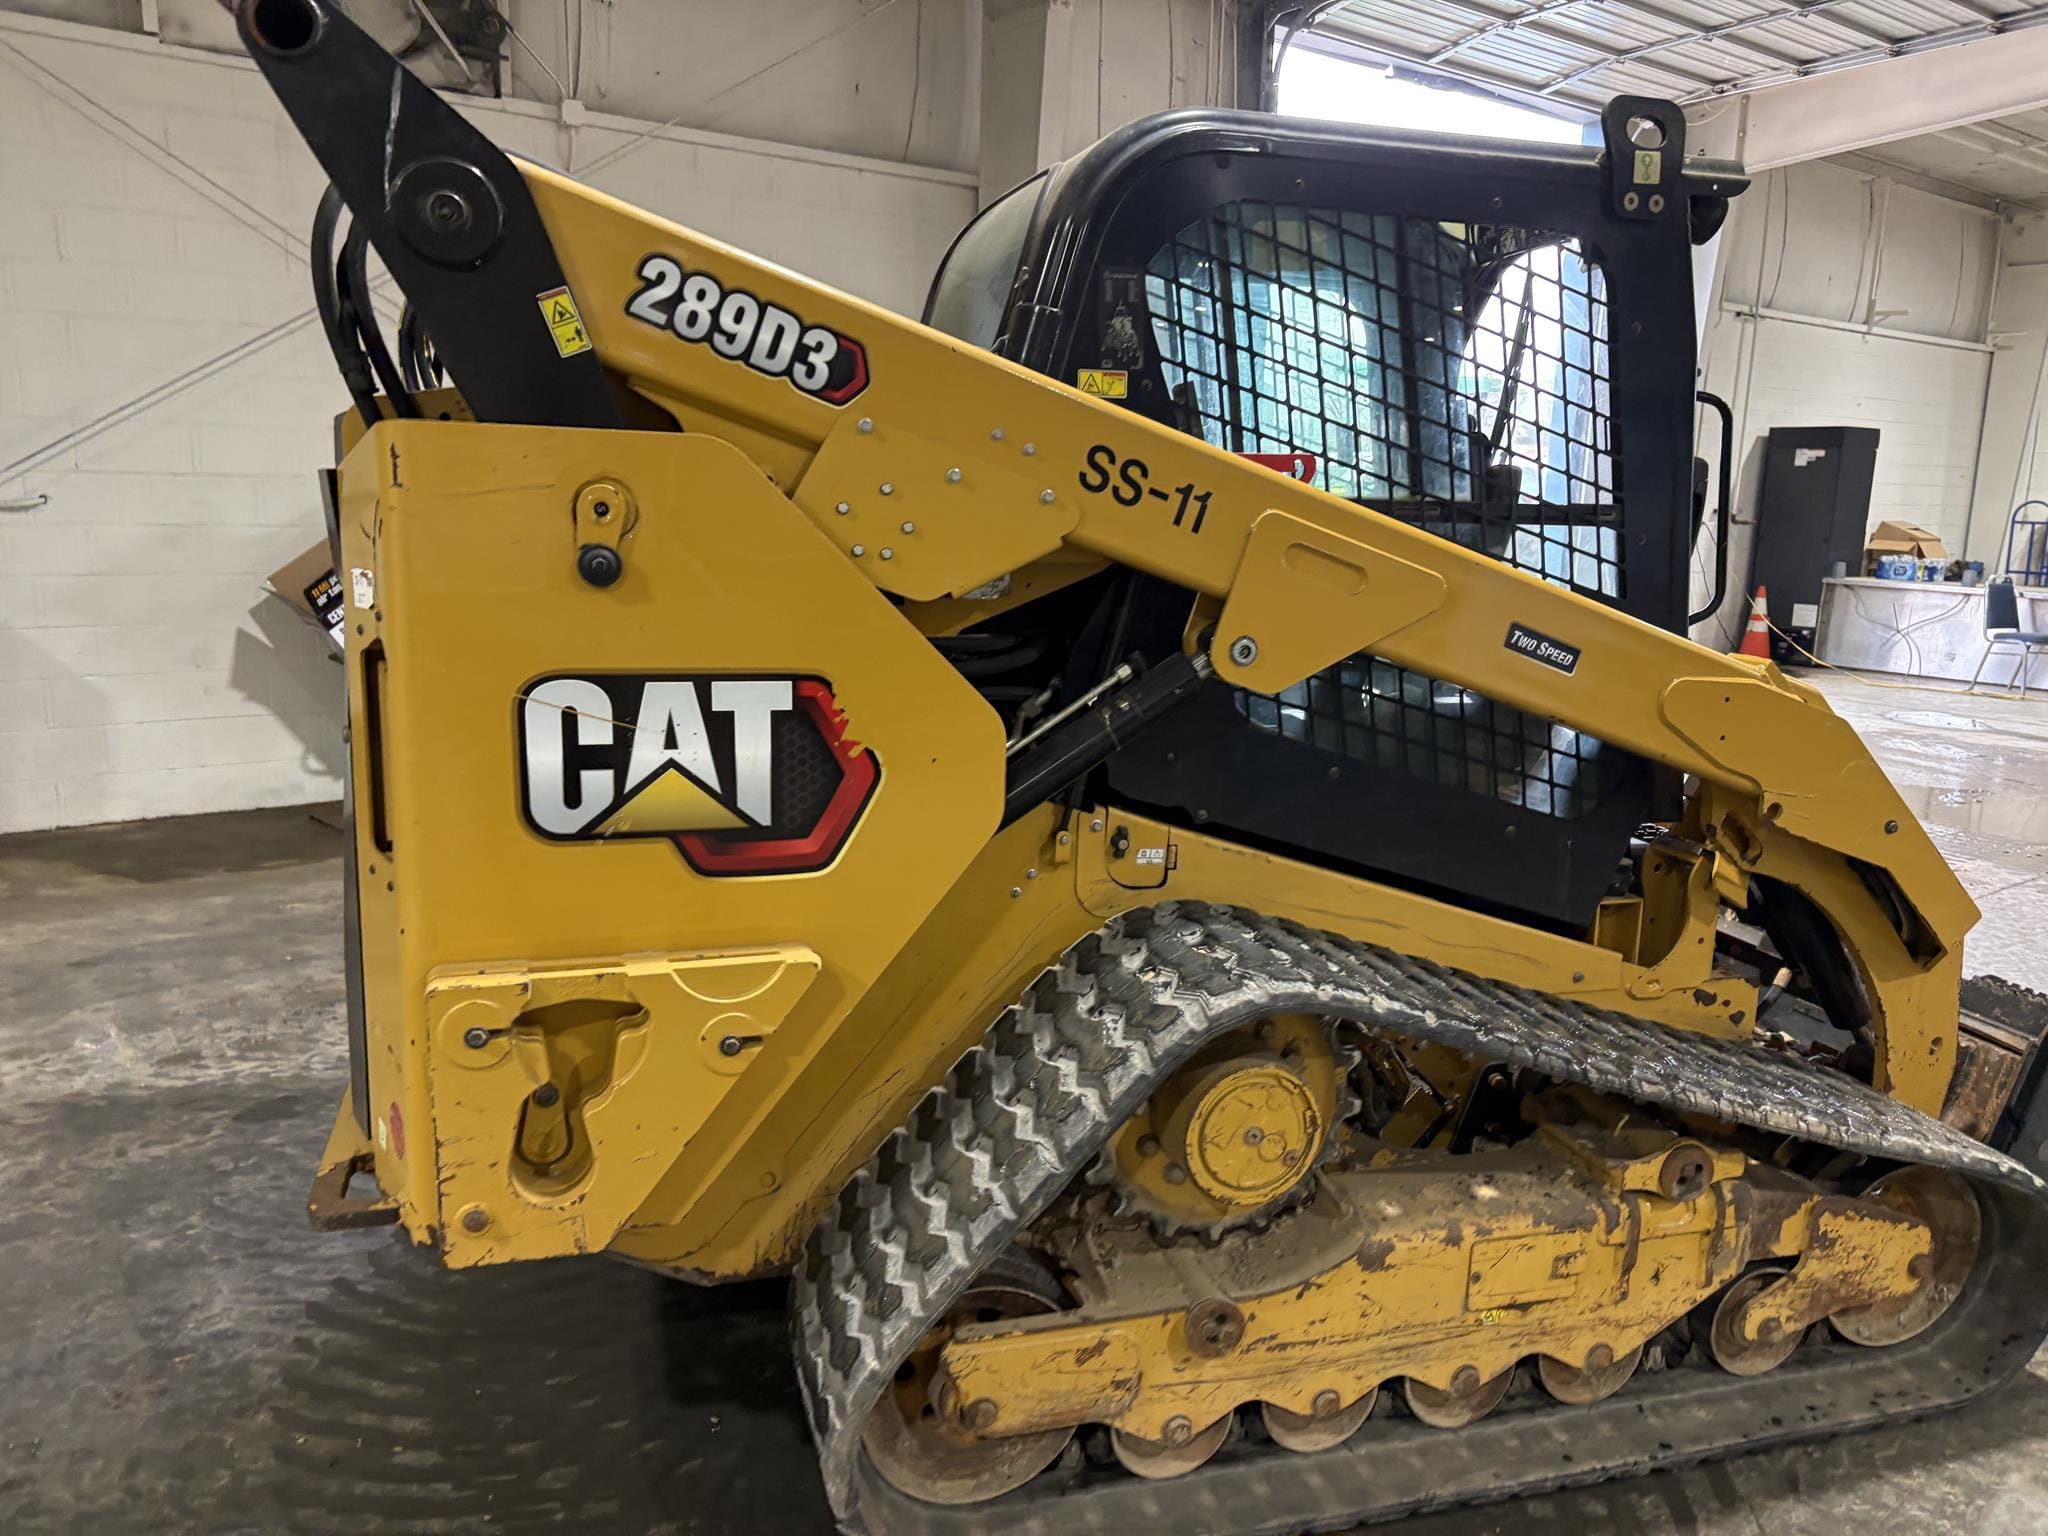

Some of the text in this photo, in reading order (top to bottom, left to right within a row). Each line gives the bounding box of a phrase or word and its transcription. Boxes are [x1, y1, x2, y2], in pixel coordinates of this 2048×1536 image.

[627, 257, 838, 391] 289D3
[1079, 444, 1213, 535] SS-11
[524, 679, 793, 834] CAT
